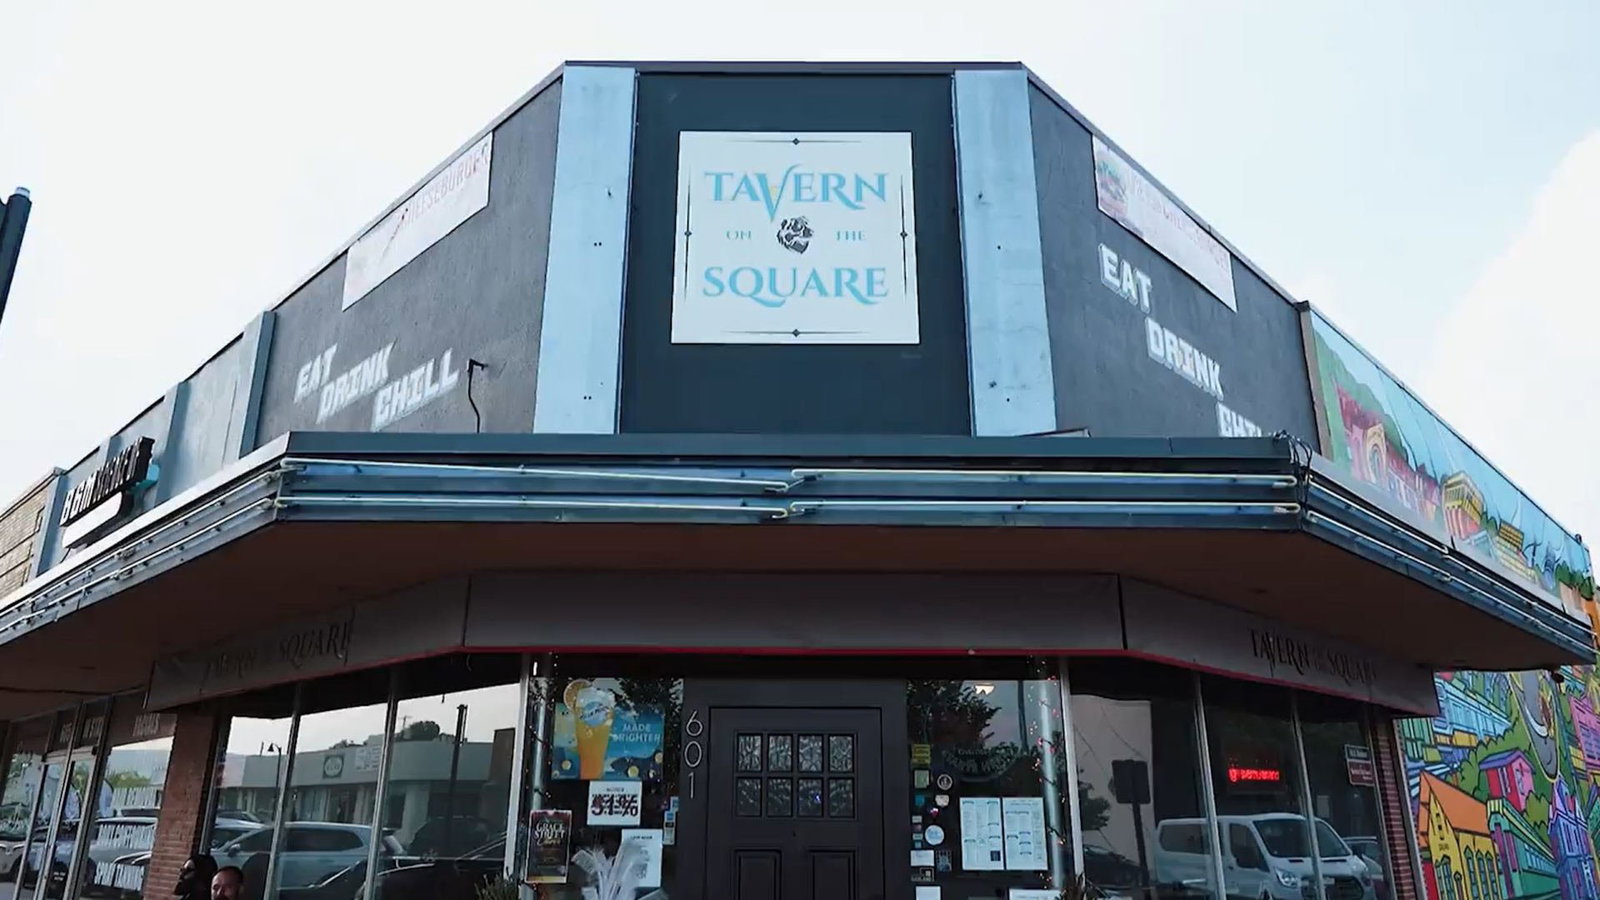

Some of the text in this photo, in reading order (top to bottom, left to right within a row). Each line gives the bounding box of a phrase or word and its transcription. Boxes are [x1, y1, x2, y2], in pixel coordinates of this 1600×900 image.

[704, 164, 888, 223] TAVERN
[726, 230, 866, 241] ON THE
[702, 266, 889, 308] SQUARE
[1098, 243, 1152, 314] EAT
[293, 342, 338, 403] EAT
[315, 337, 397, 425] DRINK
[1145, 316, 1224, 401] DRINK
[371, 347, 460, 433] CHILL
[1248, 628, 1309, 678] TAVERN
[623, 723, 650, 732] MADE
[684, 710, 703, 799] 601
[534, 829, 566, 840] STREET
[536, 822, 564, 832] GRACE
